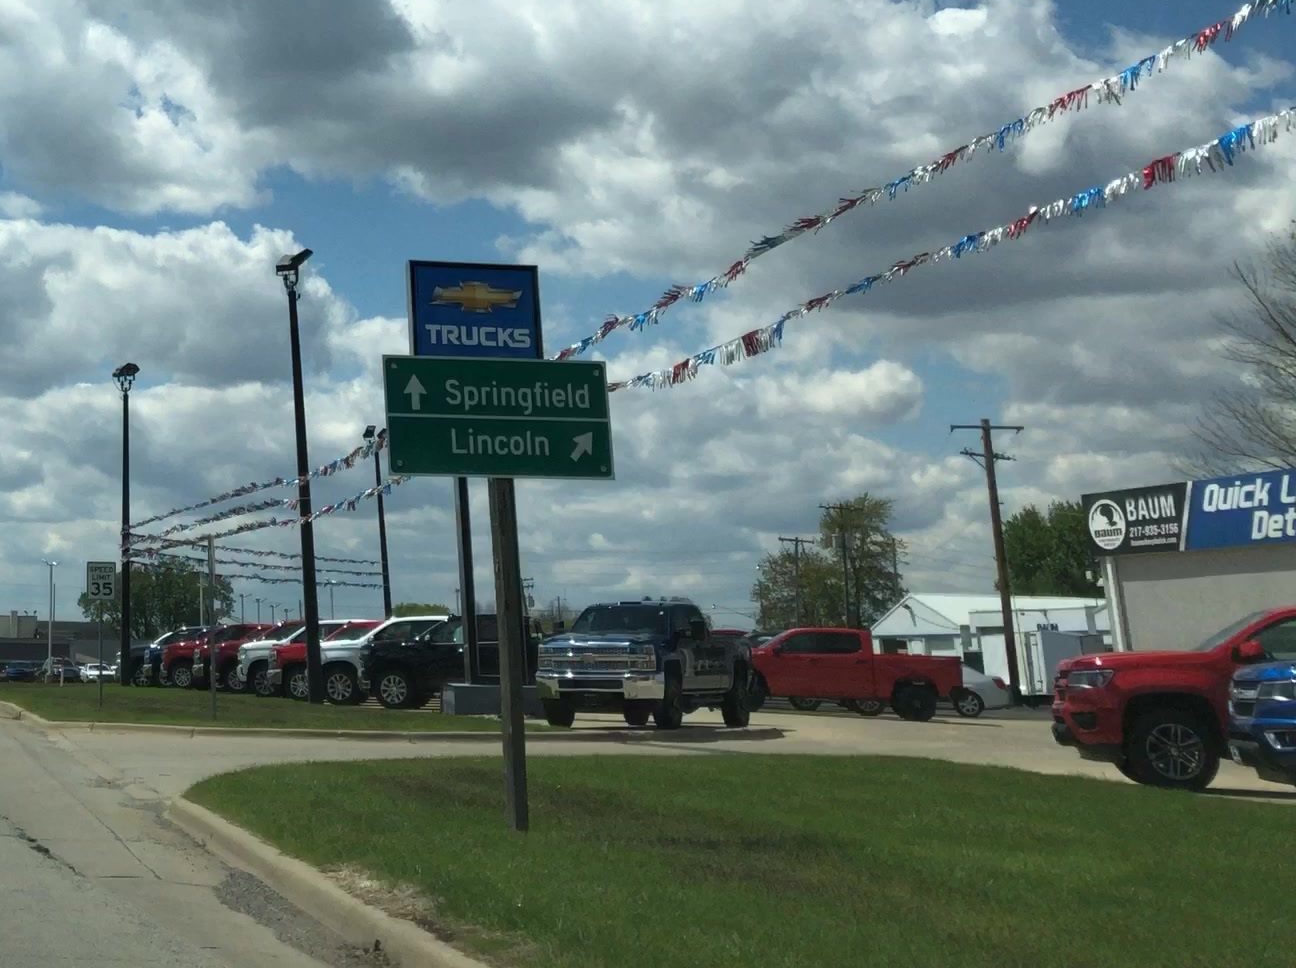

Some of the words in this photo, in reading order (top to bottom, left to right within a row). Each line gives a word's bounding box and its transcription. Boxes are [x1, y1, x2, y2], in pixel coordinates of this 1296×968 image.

[425, 323, 531, 349] TRUCKS
[445, 379, 591, 415] Springfield
[451, 428, 550, 456] Lincoln
[1125, 494, 1176, 521] BAUM
[1202, 478, 1272, 512] Quick
[1251, 507, 1296, 540] Det
[90, 582, 113, 596] 35
